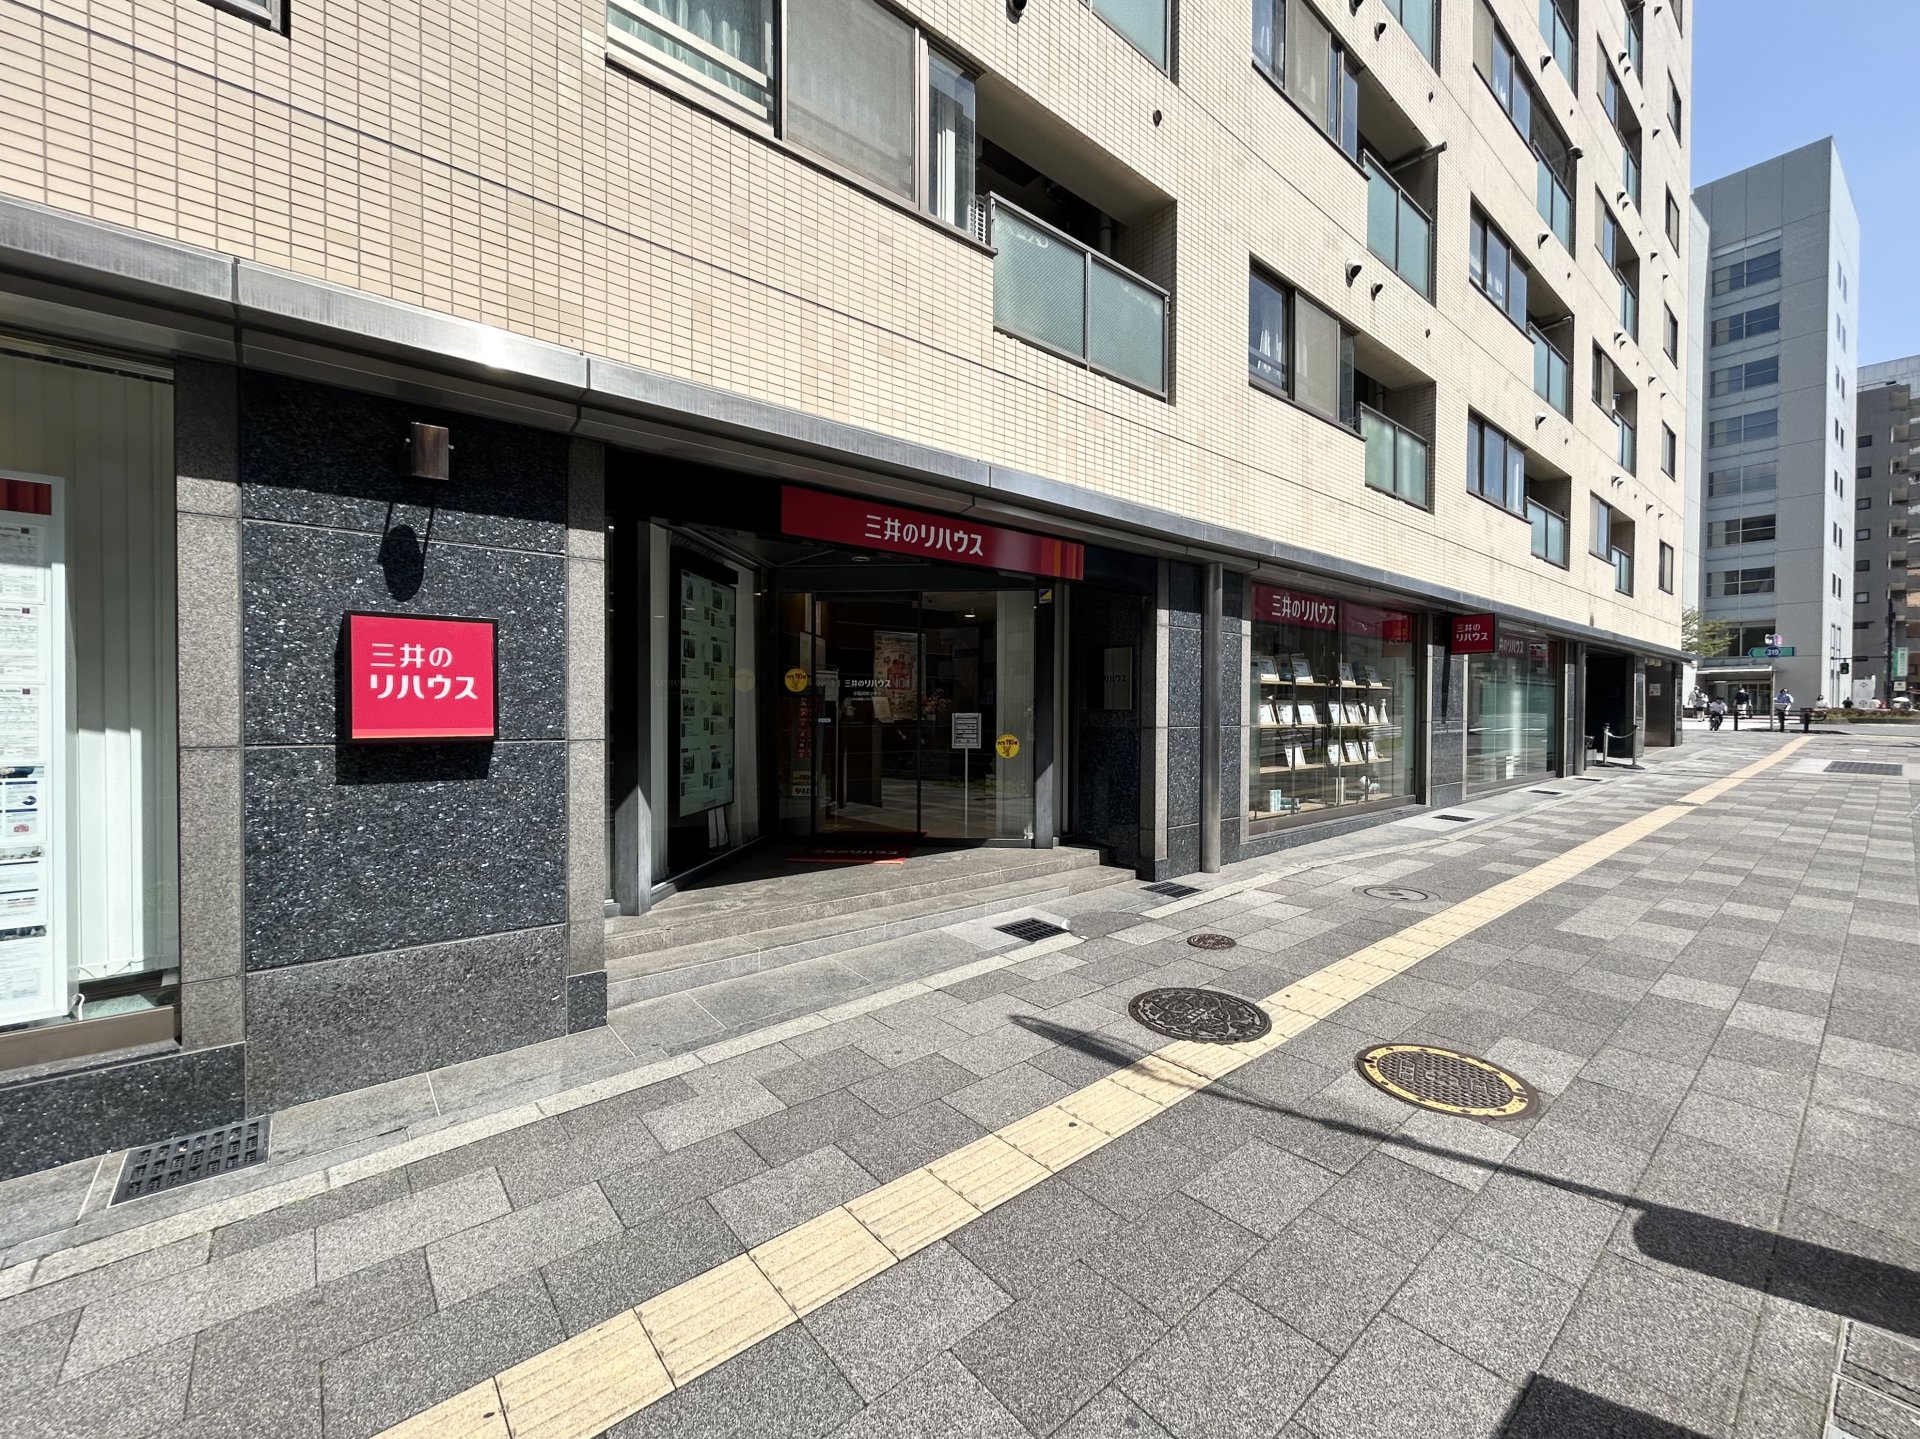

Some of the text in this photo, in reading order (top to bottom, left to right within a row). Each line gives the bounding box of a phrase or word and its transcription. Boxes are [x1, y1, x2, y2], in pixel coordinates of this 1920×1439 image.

[865, 514, 984, 557] 三井のリハウス
[1271, 593, 1337, 627] 三井のリハウス
[1456, 624, 1481, 633] 三井の
[1456, 632, 1489, 642] リハウス
[370, 642, 453, 669] 三井の
[370, 674, 478, 700] リハウス
[844, 679, 891, 688] 三井のリハウス
